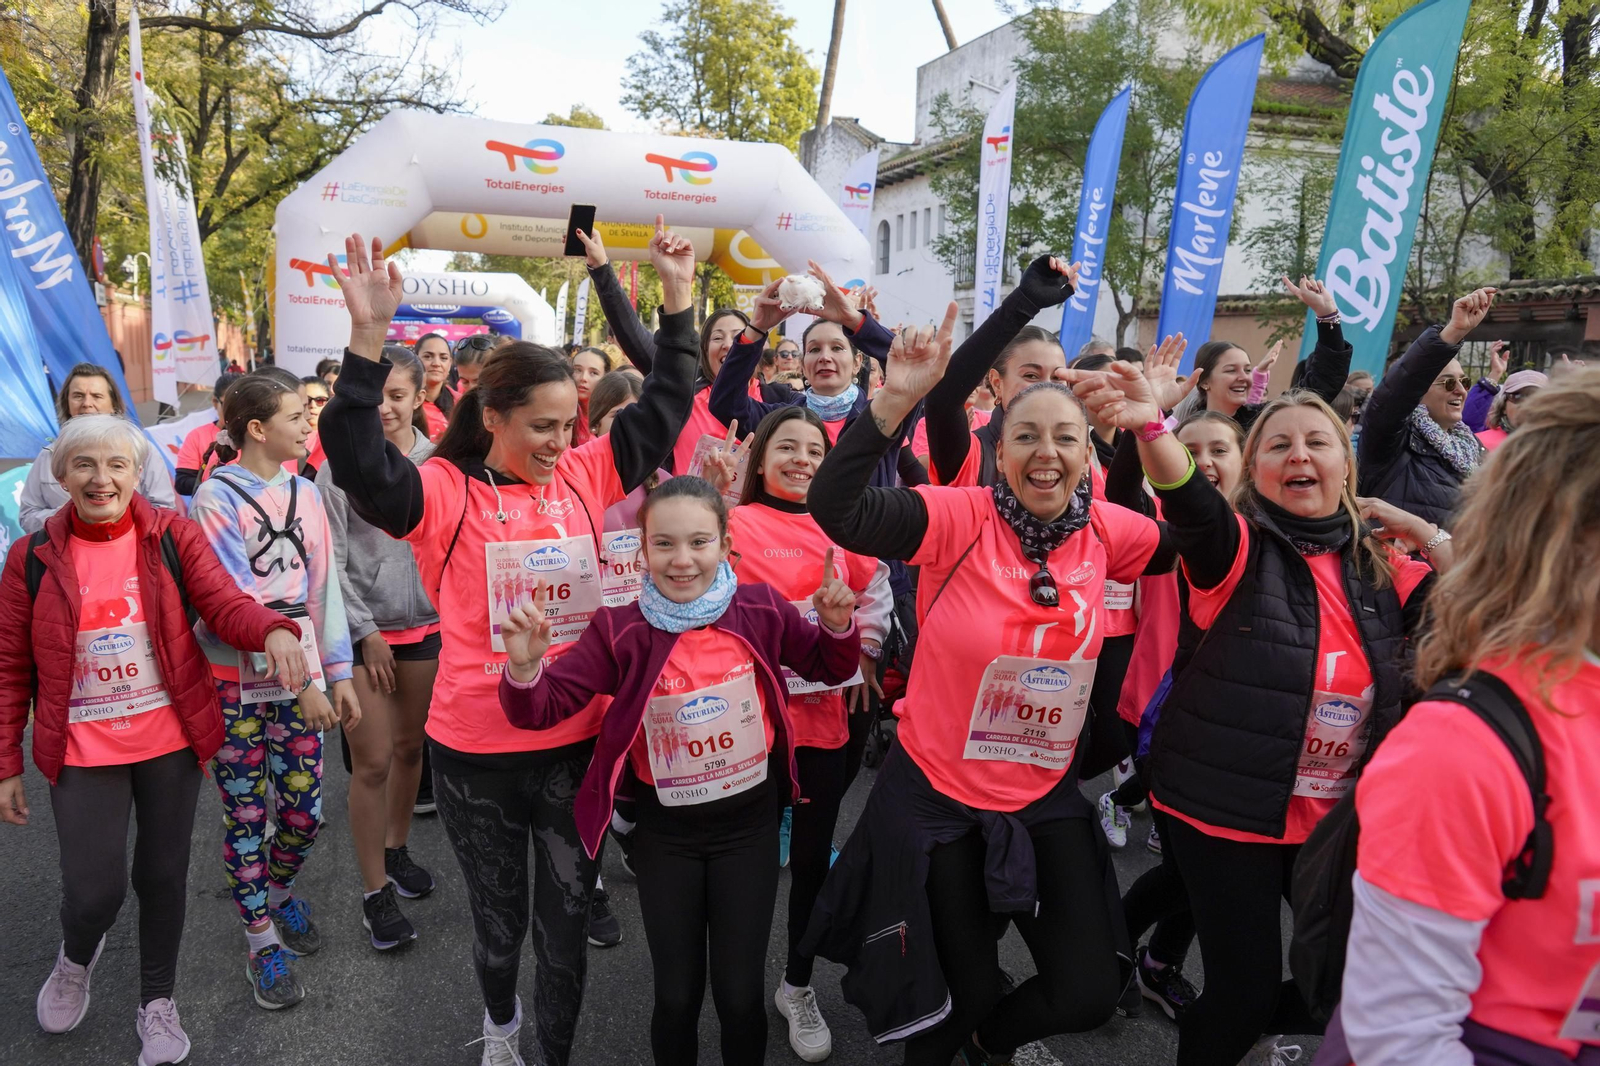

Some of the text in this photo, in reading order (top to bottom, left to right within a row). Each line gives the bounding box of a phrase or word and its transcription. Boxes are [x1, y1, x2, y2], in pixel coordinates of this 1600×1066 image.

[485, 178, 565, 195] TotalEnergies
[644, 189, 717, 204] TotalEnergies
[1325, 64, 1435, 333] Batiste
[500, 222, 567, 235] Instituto Municip
[1172, 150, 1231, 296] Marlene
[512, 234, 562, 244] de Deportes
[1070, 187, 1107, 312] Marlene
[402, 277, 489, 297] OYSHO
[288, 294, 346, 309] TotalEnerg
[287, 345, 343, 356] totalenergie
[610, 541, 640, 551] ASTURIANA
[764, 548, 803, 559] OYSHO
[614, 560, 642, 575] 016
[544, 608, 560, 617] 797
[568, 614, 589, 622] SEVILLA
[98, 663, 139, 682] 016
[993, 673, 1017, 682] SUMA
[657, 677, 686, 690] SHO
[1024, 673, 1067, 687] ASTURIANA
[111, 684, 131, 693] 3659
[121, 691, 138, 700] MUJER
[141, 686, 159, 695] SEVILLA
[251, 690, 281, 699] OYSHO
[135, 696, 164, 709] Santander
[80, 706, 113, 717] OYSHO
[680, 704, 726, 722] ASTURIANA
[1017, 704, 1063, 725] 016
[111, 720, 131, 730] 2025
[652, 716, 674, 725] SUMA
[1022, 728, 1046, 738] 2119
[688, 731, 734, 758] 016
[985, 733, 1011, 742] CARRERA
[1029, 739, 1049, 747] MUJER
[978, 744, 1017, 755] OYSHO
[1306, 738, 1350, 757] 016
[704, 758, 727, 771] 5799
[1306, 760, 1328, 768] 2121
[671, 777, 697, 786] CARRERA
[715, 768, 734, 778] MUJER
[738, 758, 757, 771] SEVILLA
[731, 769, 762, 788] Santander
[670, 787, 708, 800] OYSHO
